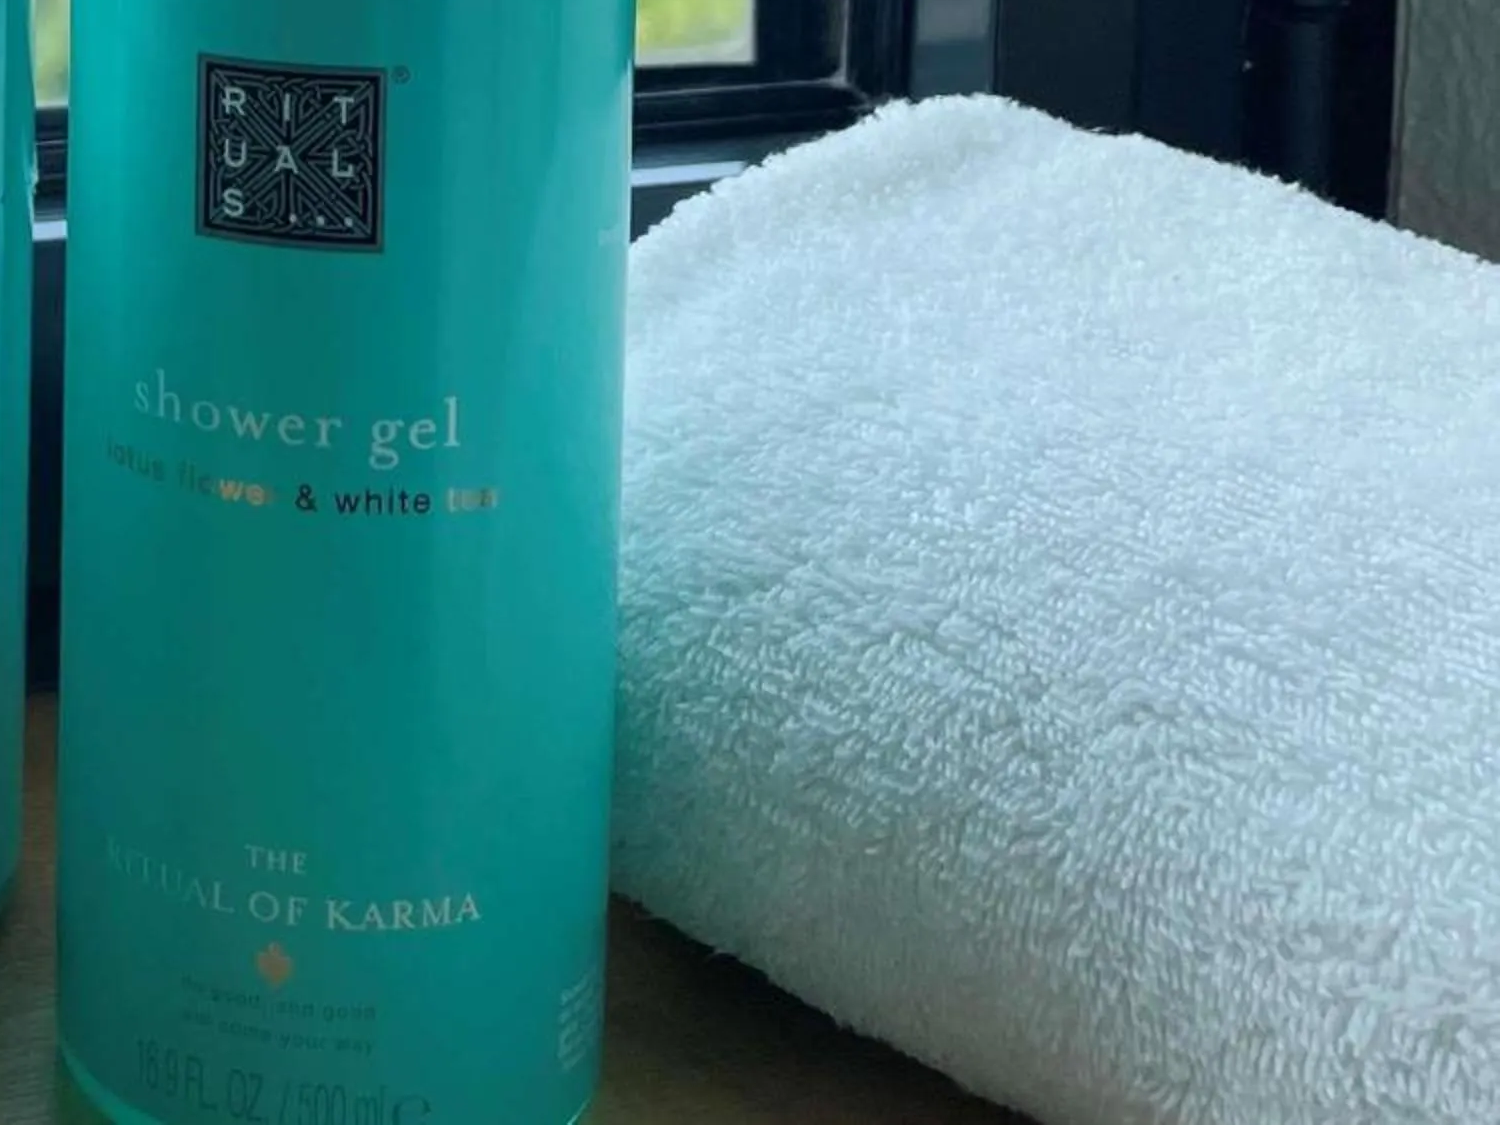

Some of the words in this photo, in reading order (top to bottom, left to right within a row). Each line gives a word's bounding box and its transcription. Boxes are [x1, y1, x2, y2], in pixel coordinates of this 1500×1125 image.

[134, 369, 341, 450] shower
[368, 396, 461, 471] gel
[293, 482, 319, 513] &
[334, 485, 432, 515] white
[106, 835, 236, 915] RITUAL
[248, 890, 309, 927] OF
[325, 890, 484, 933] KARMA
[243, 843, 309, 877] THE
